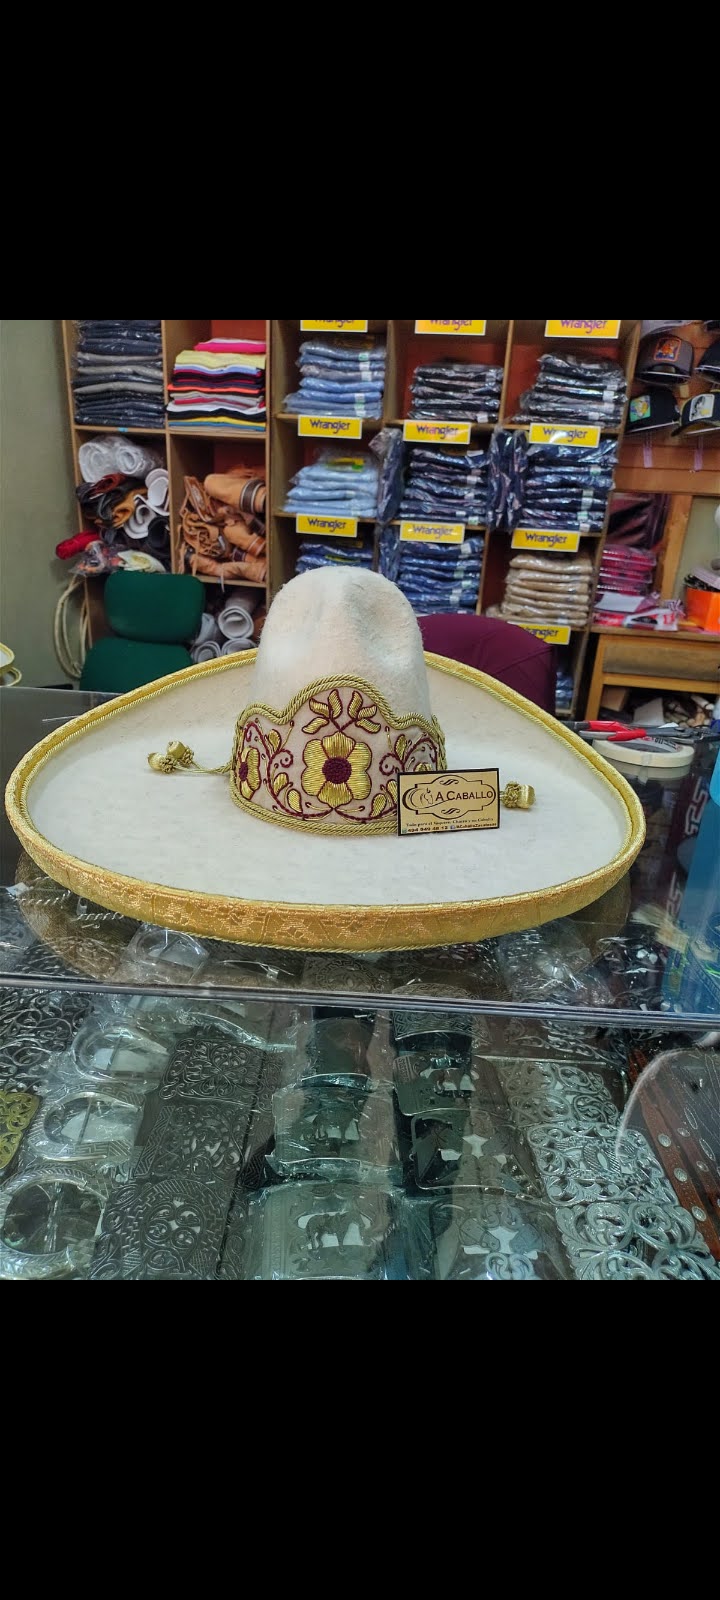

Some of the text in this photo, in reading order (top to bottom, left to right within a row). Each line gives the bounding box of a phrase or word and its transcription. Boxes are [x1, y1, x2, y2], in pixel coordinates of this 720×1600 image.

[560, 320, 608, 333] Wrangler
[309, 419, 350, 434] Wrangler
[416, 424, 458, 440] Wrangler
[543, 427, 587, 442] Wrgler
[307, 518, 346, 532] Wrangler
[413, 525, 453, 540] Wrangler
[525, 532, 567, 547] Wrangler
[525, 626, 558, 638] rangler
[435, 790, 493, 801] A CABALLO
